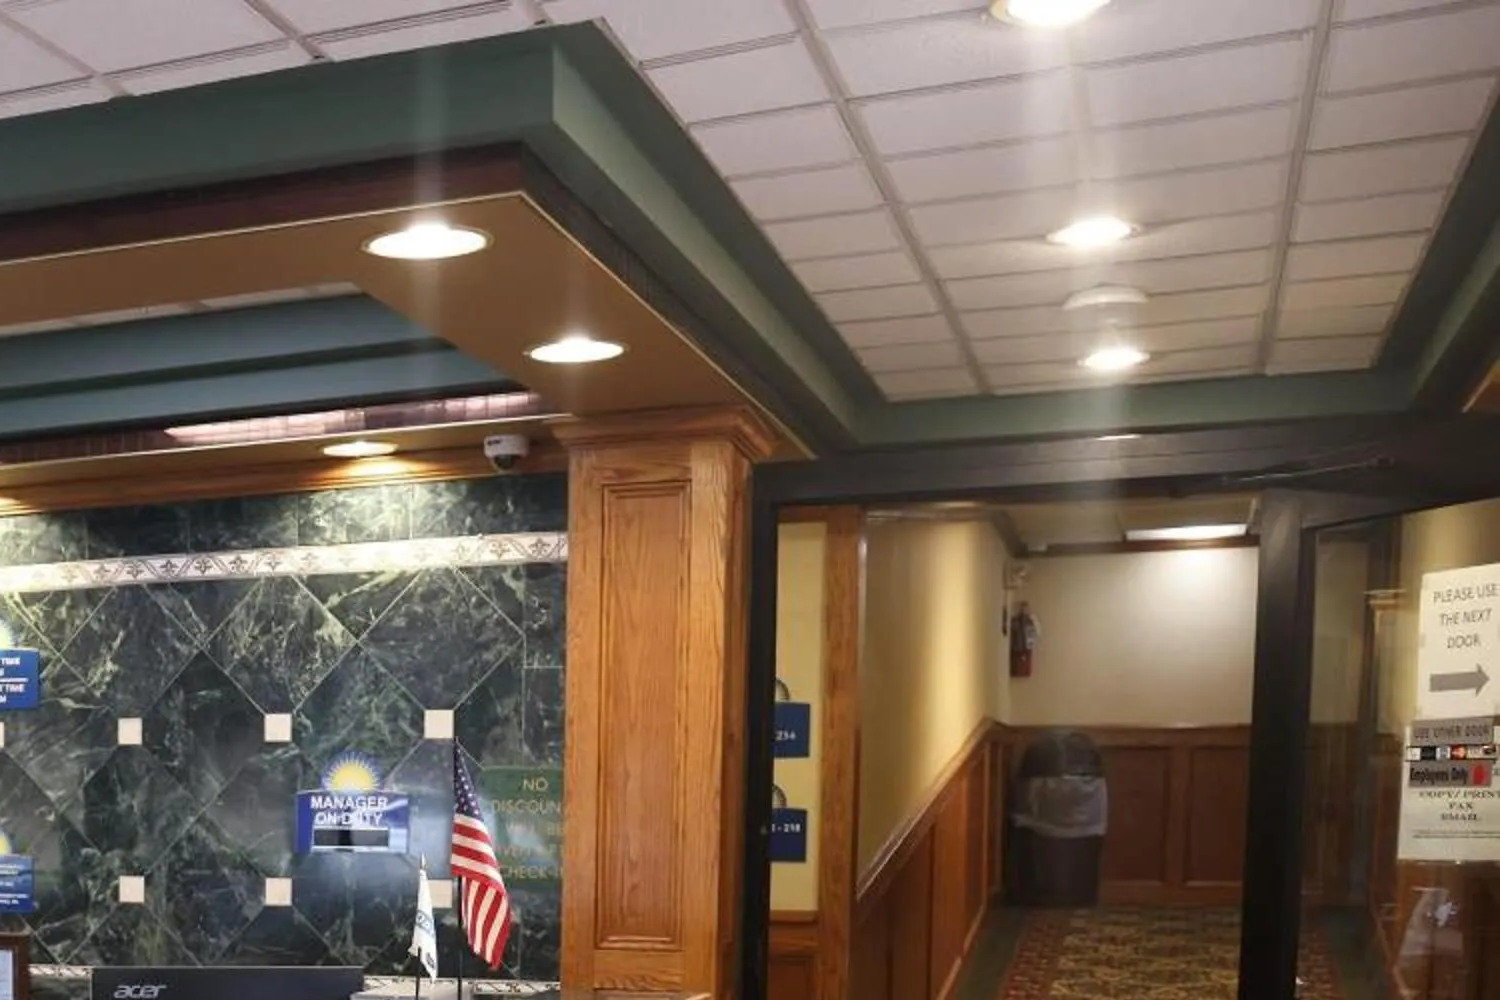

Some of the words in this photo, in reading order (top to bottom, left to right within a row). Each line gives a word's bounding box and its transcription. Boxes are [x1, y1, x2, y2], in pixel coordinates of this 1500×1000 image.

[1433, 586, 1475, 604] PLEASE
[1476, 583, 1500, 599] USE
[1440, 612, 1460, 626] THE
[1463, 608, 1492, 624] NEXT
[1447, 633, 1482, 649] DOOR
[523, 777, 549, 792] NO
[311, 795, 388, 809] MANAGER
[315, 812, 338, 825] ON
[113, 984, 167, 999] acer
